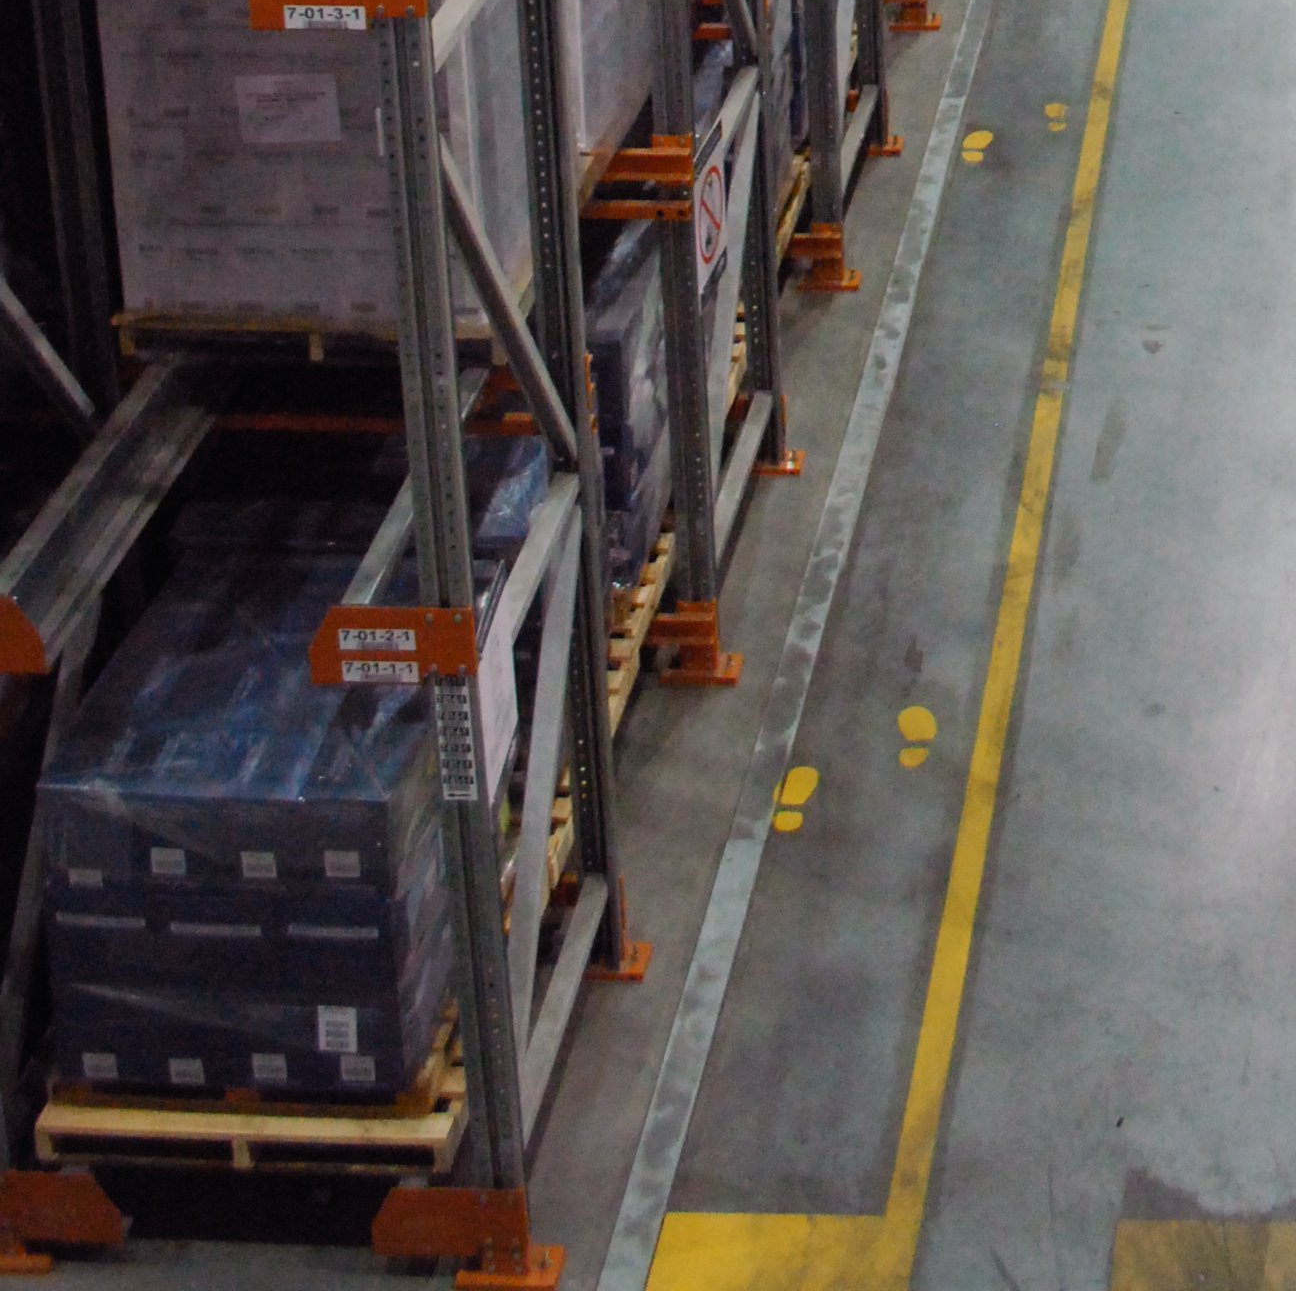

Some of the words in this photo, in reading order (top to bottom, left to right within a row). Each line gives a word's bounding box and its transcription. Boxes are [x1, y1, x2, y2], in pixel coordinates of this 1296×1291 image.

[287, 7, 360, 20] 7-01-3-1
[342, 630, 410, 642] 7-01-2-1
[344, 662, 414, 674] 7-01-1-1
